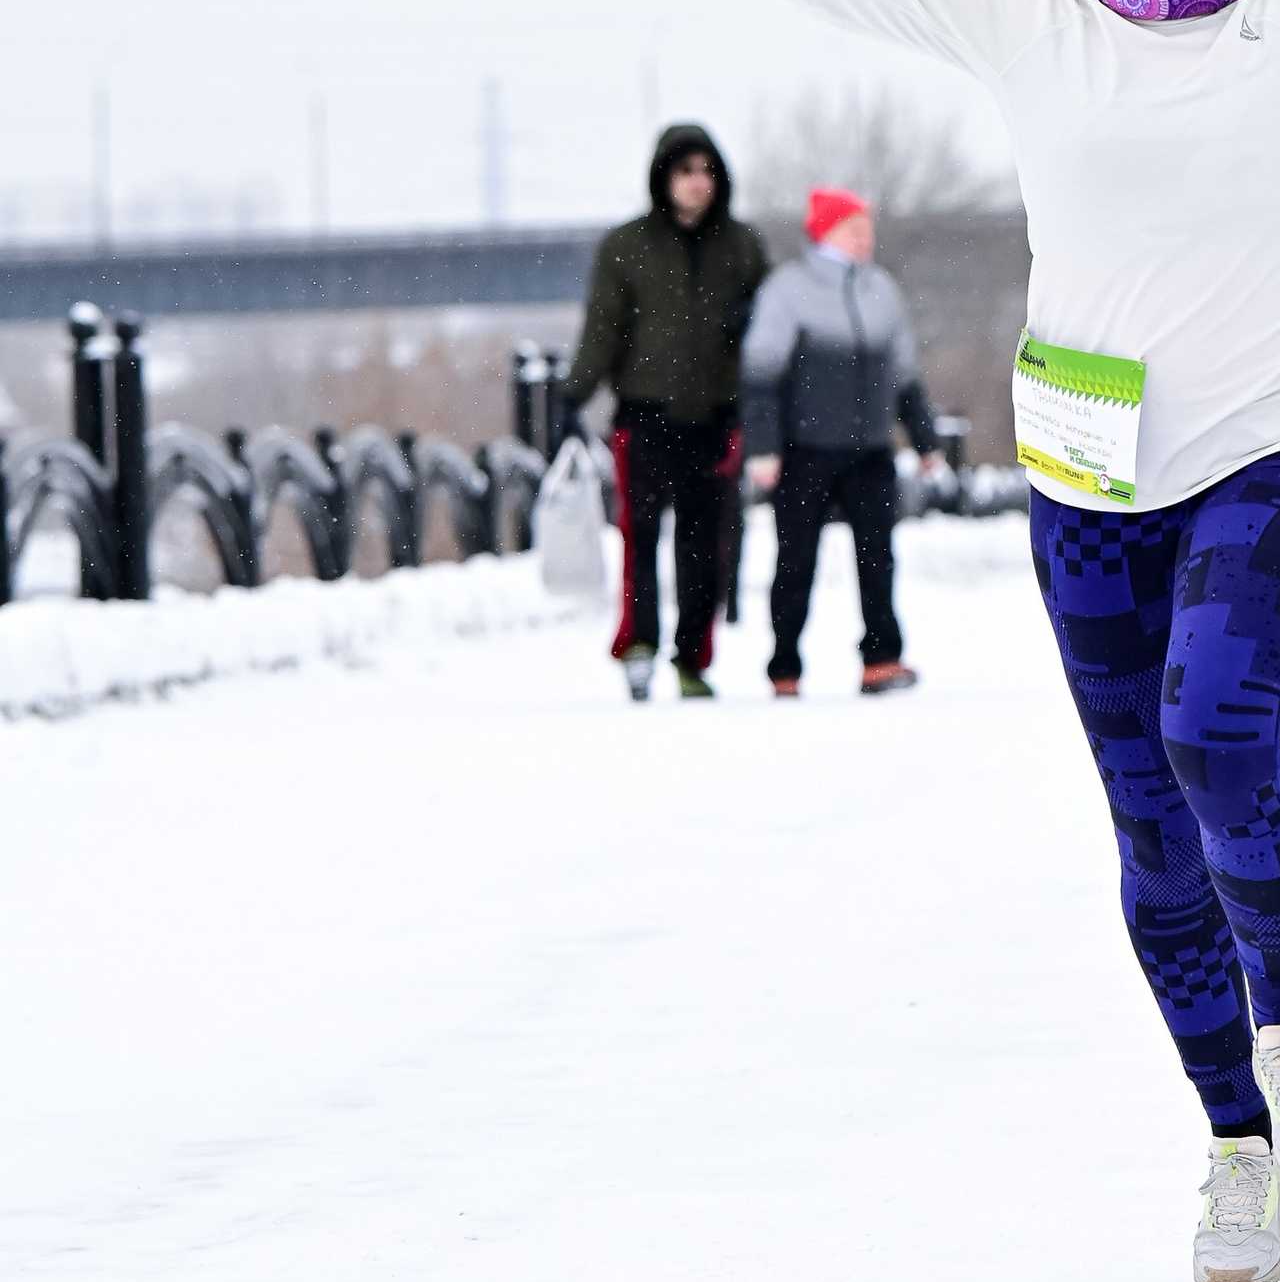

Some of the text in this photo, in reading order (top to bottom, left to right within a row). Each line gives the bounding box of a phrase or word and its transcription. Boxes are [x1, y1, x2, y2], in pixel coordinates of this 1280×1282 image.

[1069, 447, 1085, 458] БЕГУ
[1069, 455, 1107, 472] И ОБЕЩАЮ
